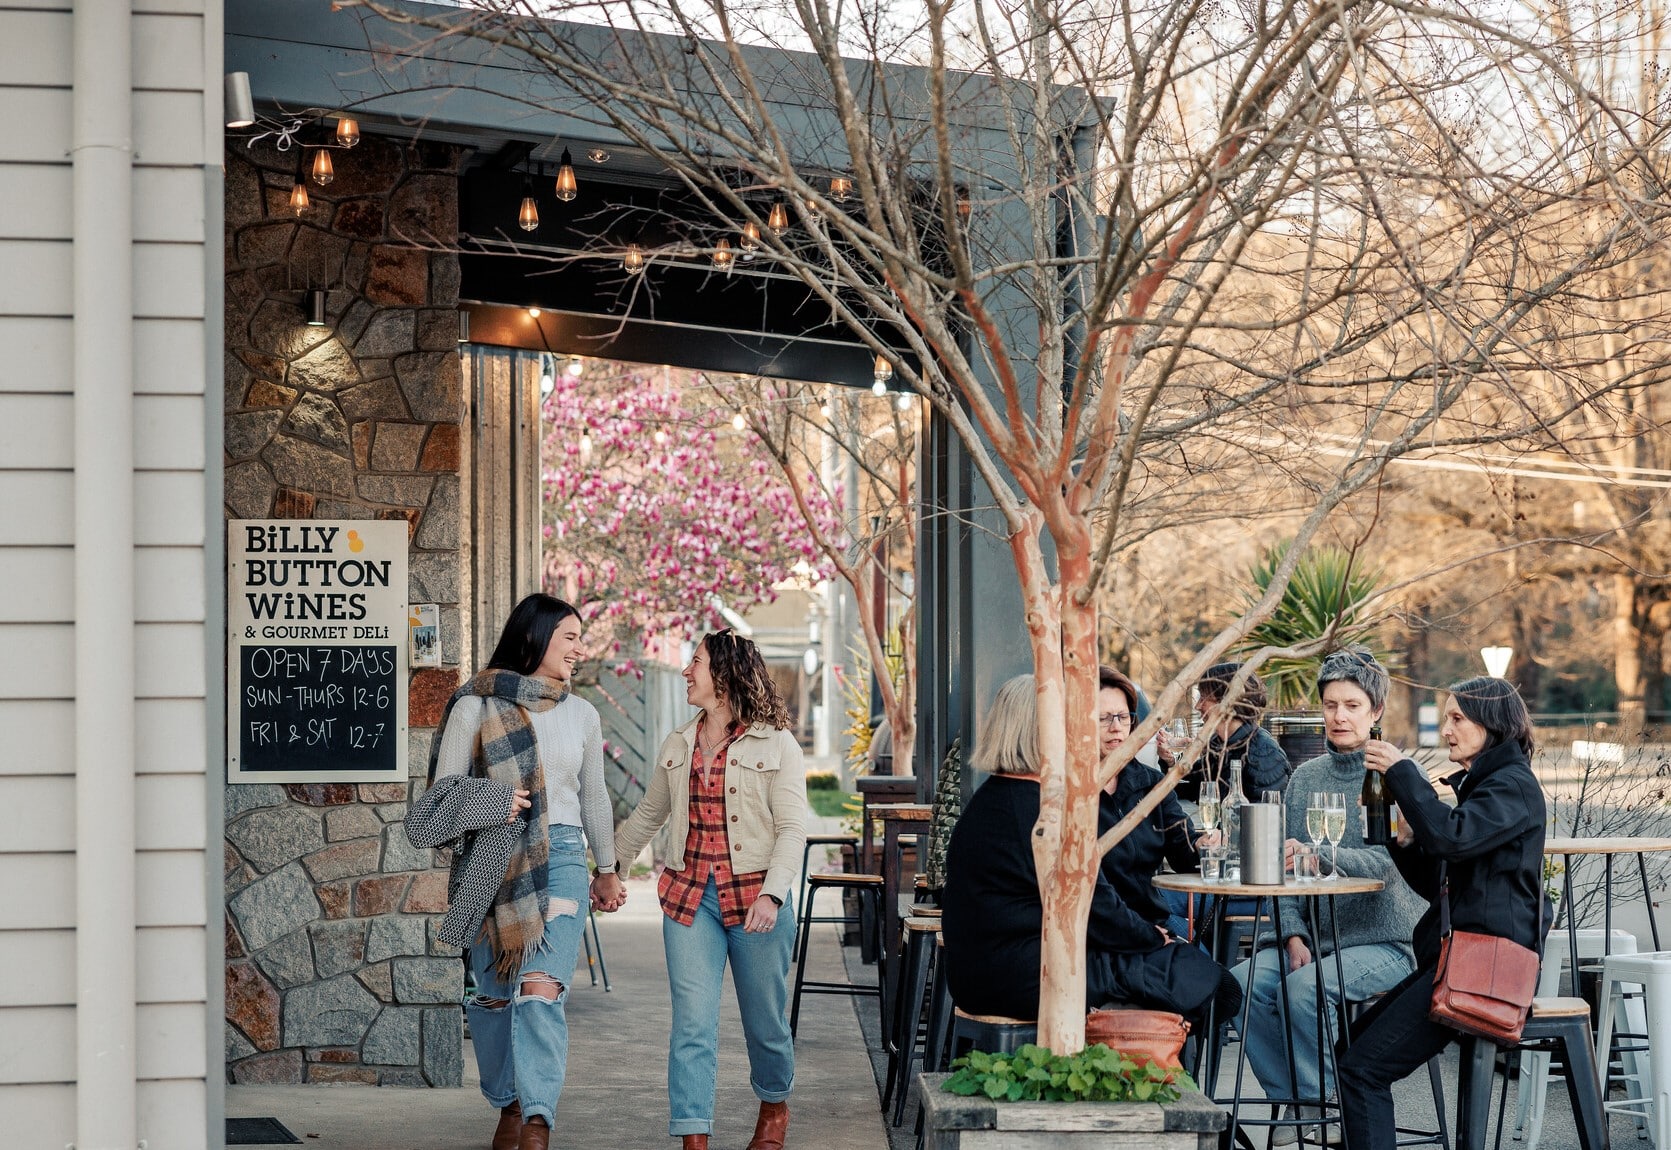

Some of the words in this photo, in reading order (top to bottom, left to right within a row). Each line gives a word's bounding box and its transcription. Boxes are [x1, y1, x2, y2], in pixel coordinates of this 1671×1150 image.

[245, 560, 391, 587] BUTTON
[245, 626, 256, 638] &
[262, 626, 347, 639] GOURMET
[251, 648, 310, 678] OPEN
[317, 650, 331, 681] 7
[341, 648, 394, 678] DAYS
[353, 685, 389, 711] 12-6
[251, 722, 278, 746] FRI
[289, 724, 301, 743] &
[306, 718, 337, 749] SAT
[350, 723, 384, 748] 12-7
